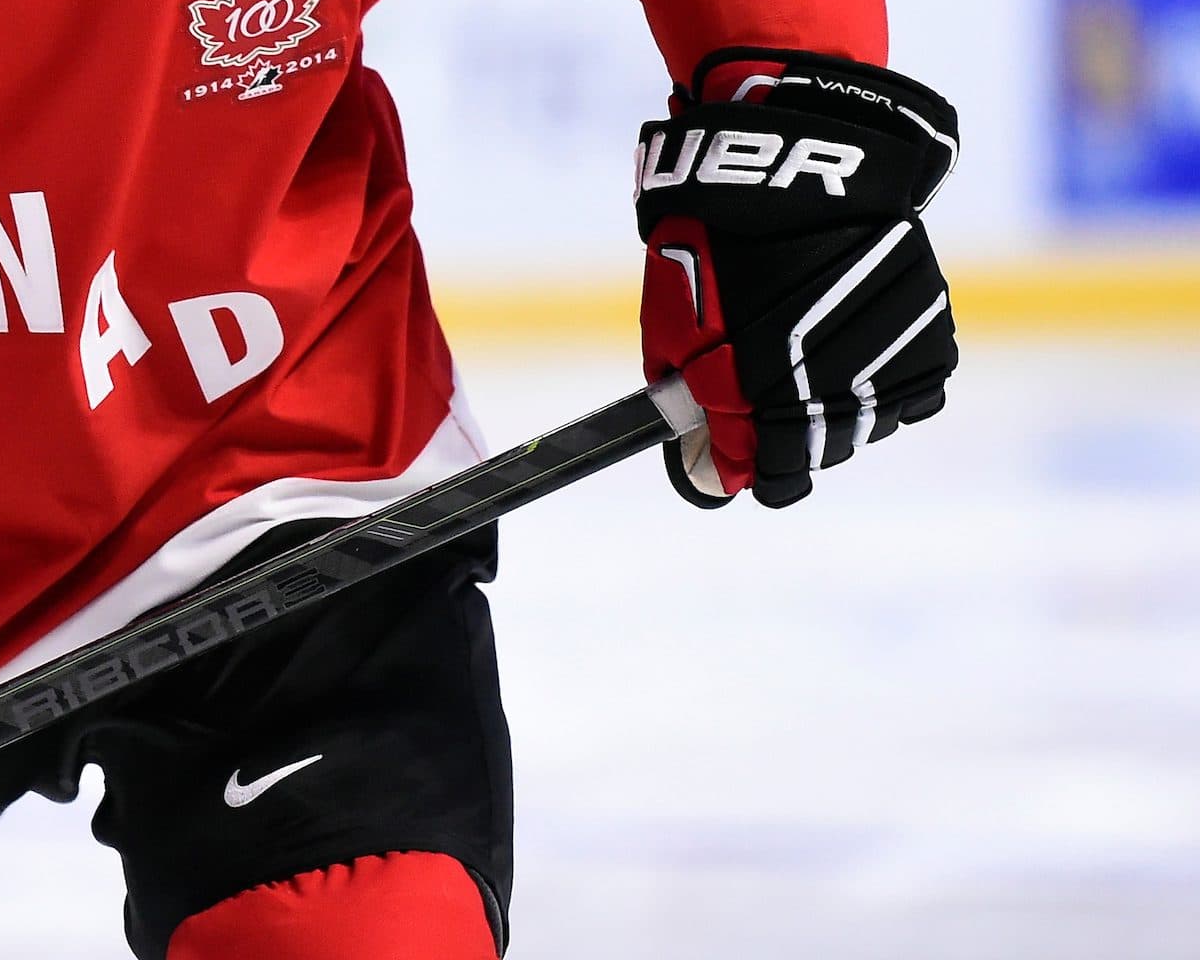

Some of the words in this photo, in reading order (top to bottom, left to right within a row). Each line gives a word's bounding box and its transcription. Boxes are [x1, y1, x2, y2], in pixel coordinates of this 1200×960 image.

[183, 77, 234, 101] 1914
[286, 48, 338, 74] 2014
[815, 76, 894, 111] VAPOR
[634, 128, 866, 197] UER
